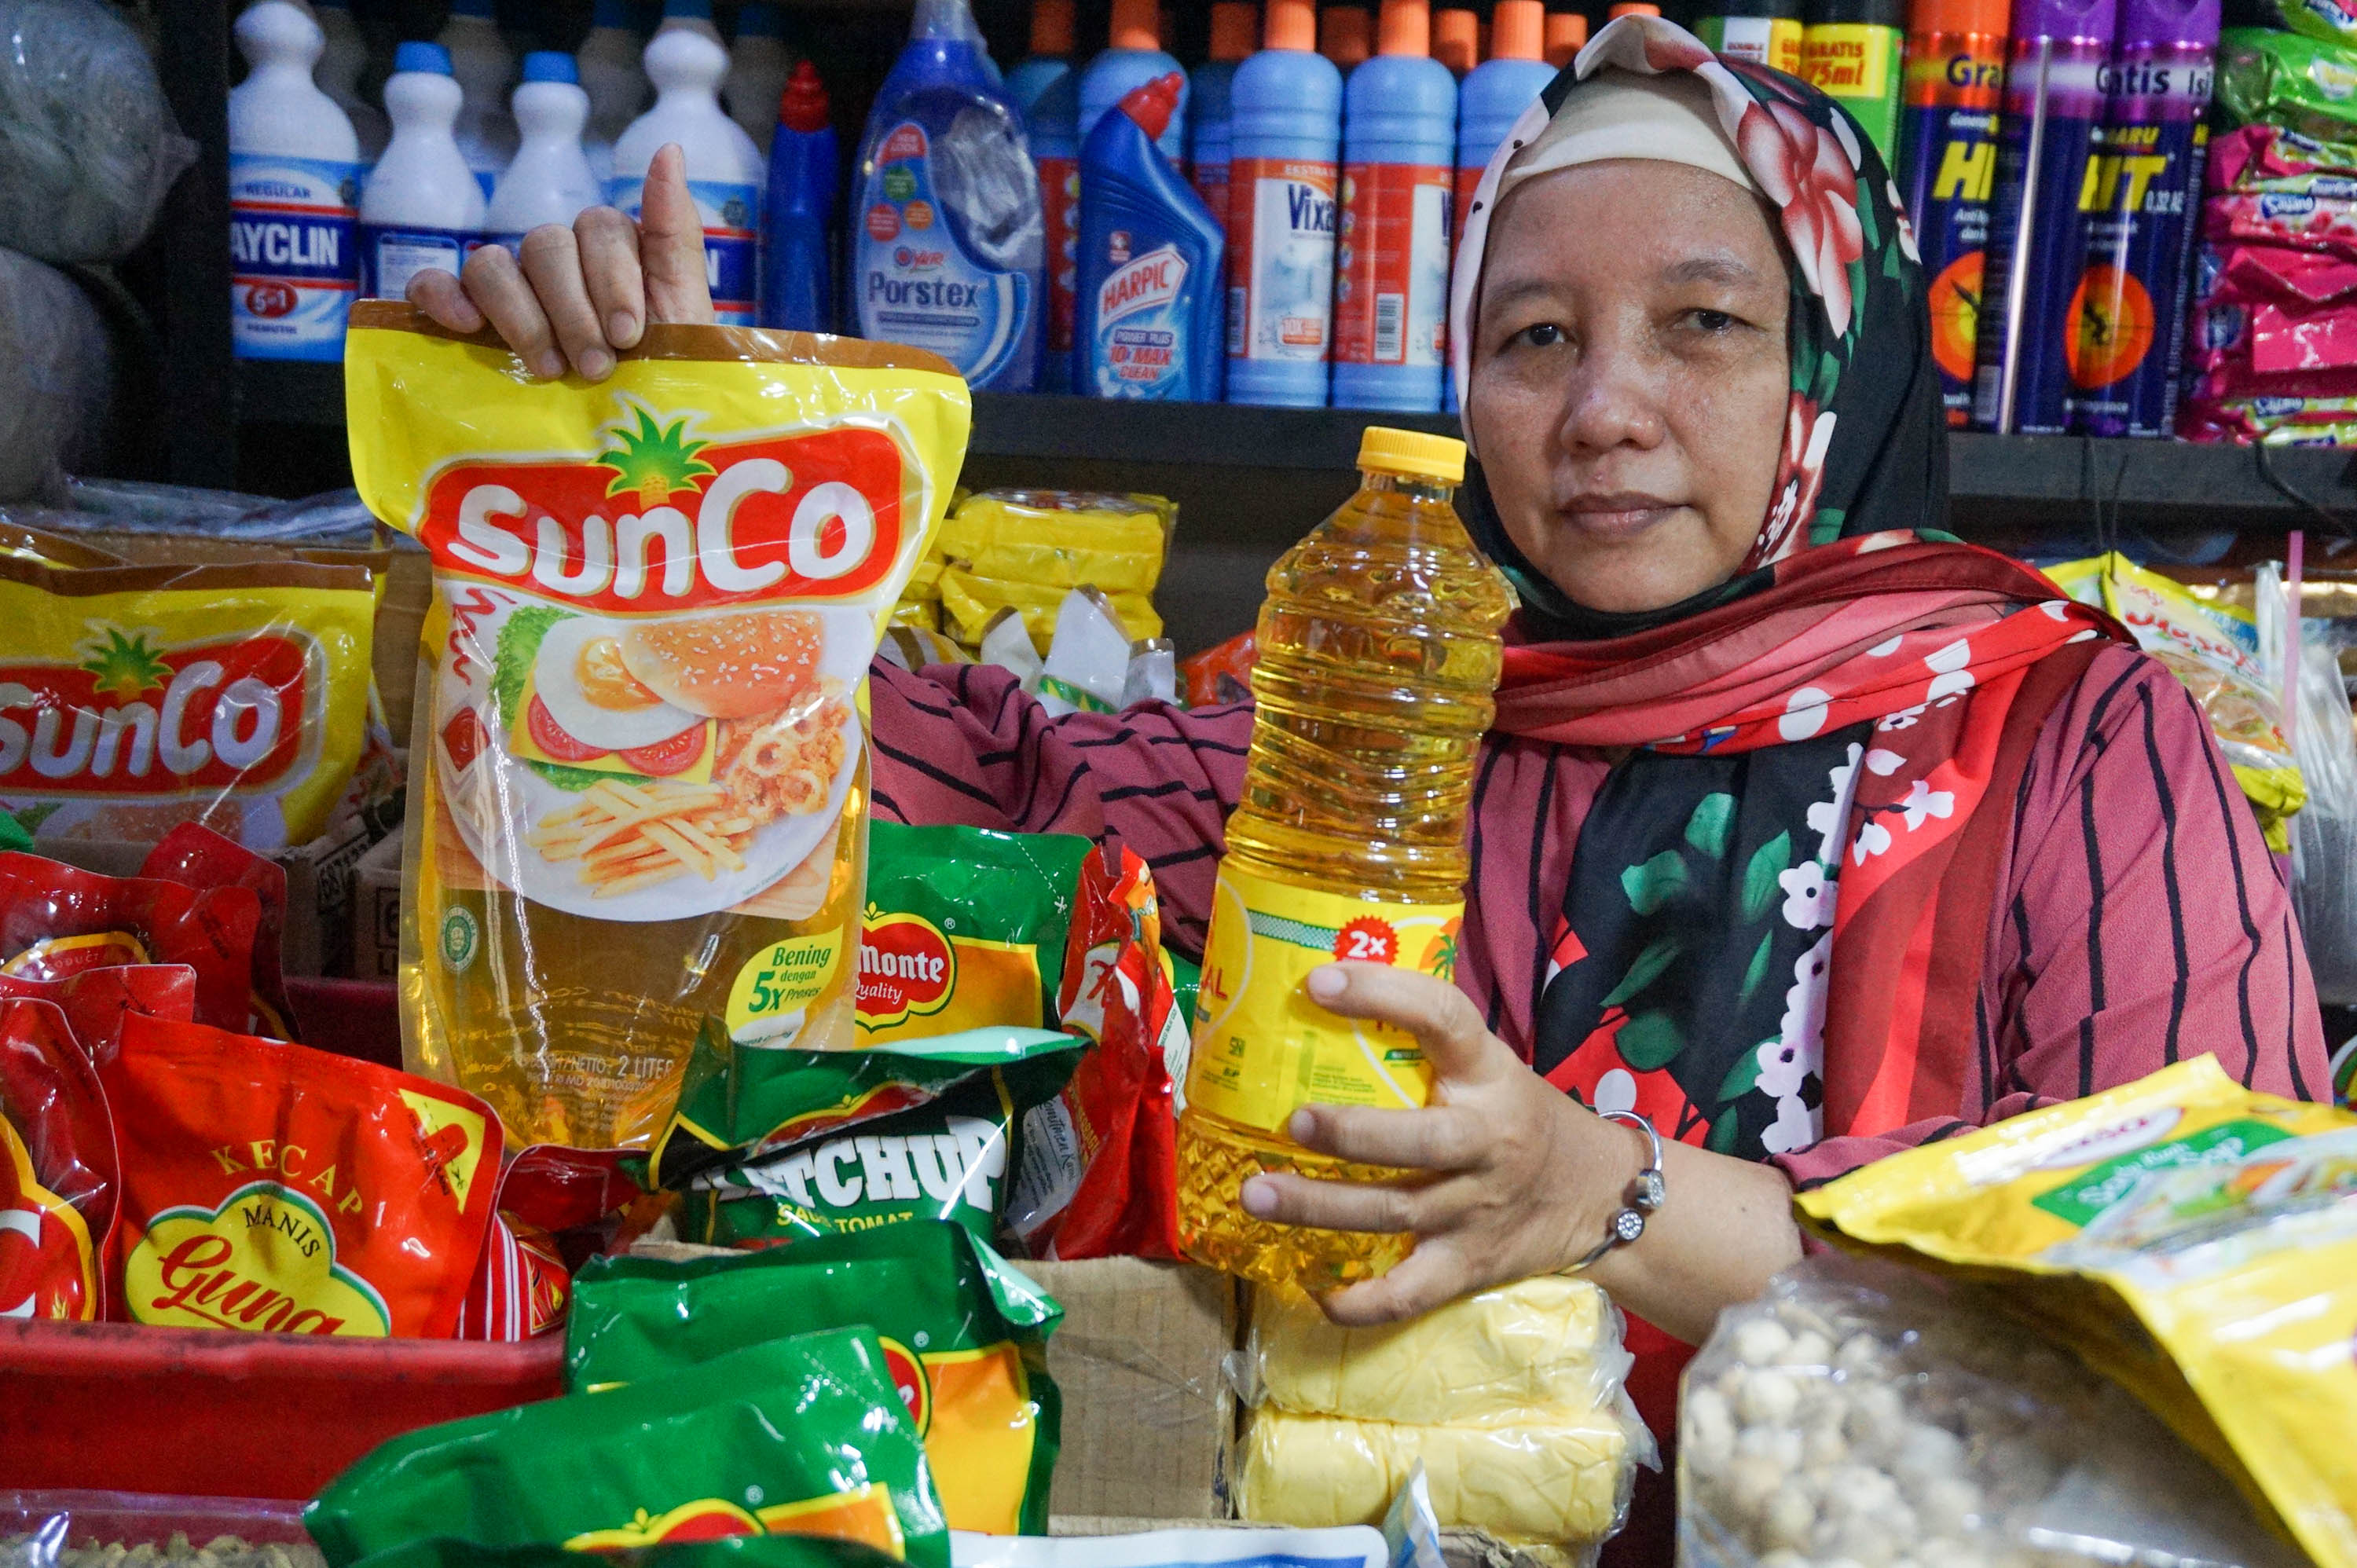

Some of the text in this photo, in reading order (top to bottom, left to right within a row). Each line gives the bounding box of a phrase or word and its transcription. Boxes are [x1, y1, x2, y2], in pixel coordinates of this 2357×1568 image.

[869, 269, 979, 309] Porstex
[1102, 259, 1170, 315] HARPIC
[447, 457, 876, 599] SunCo
[772, 944, 831, 968] Bening
[1347, 930, 1387, 958] 2x
[780, 969, 816, 984] dengan
[860, 945, 944, 984] Monte
[786, 986, 821, 1002] Proses
[618, 1055, 629, 1078] 2
[634, 1057, 674, 1079] LITER
[210, 1138, 363, 1215] KECAP
[242, 1204, 321, 1258] MANIS
